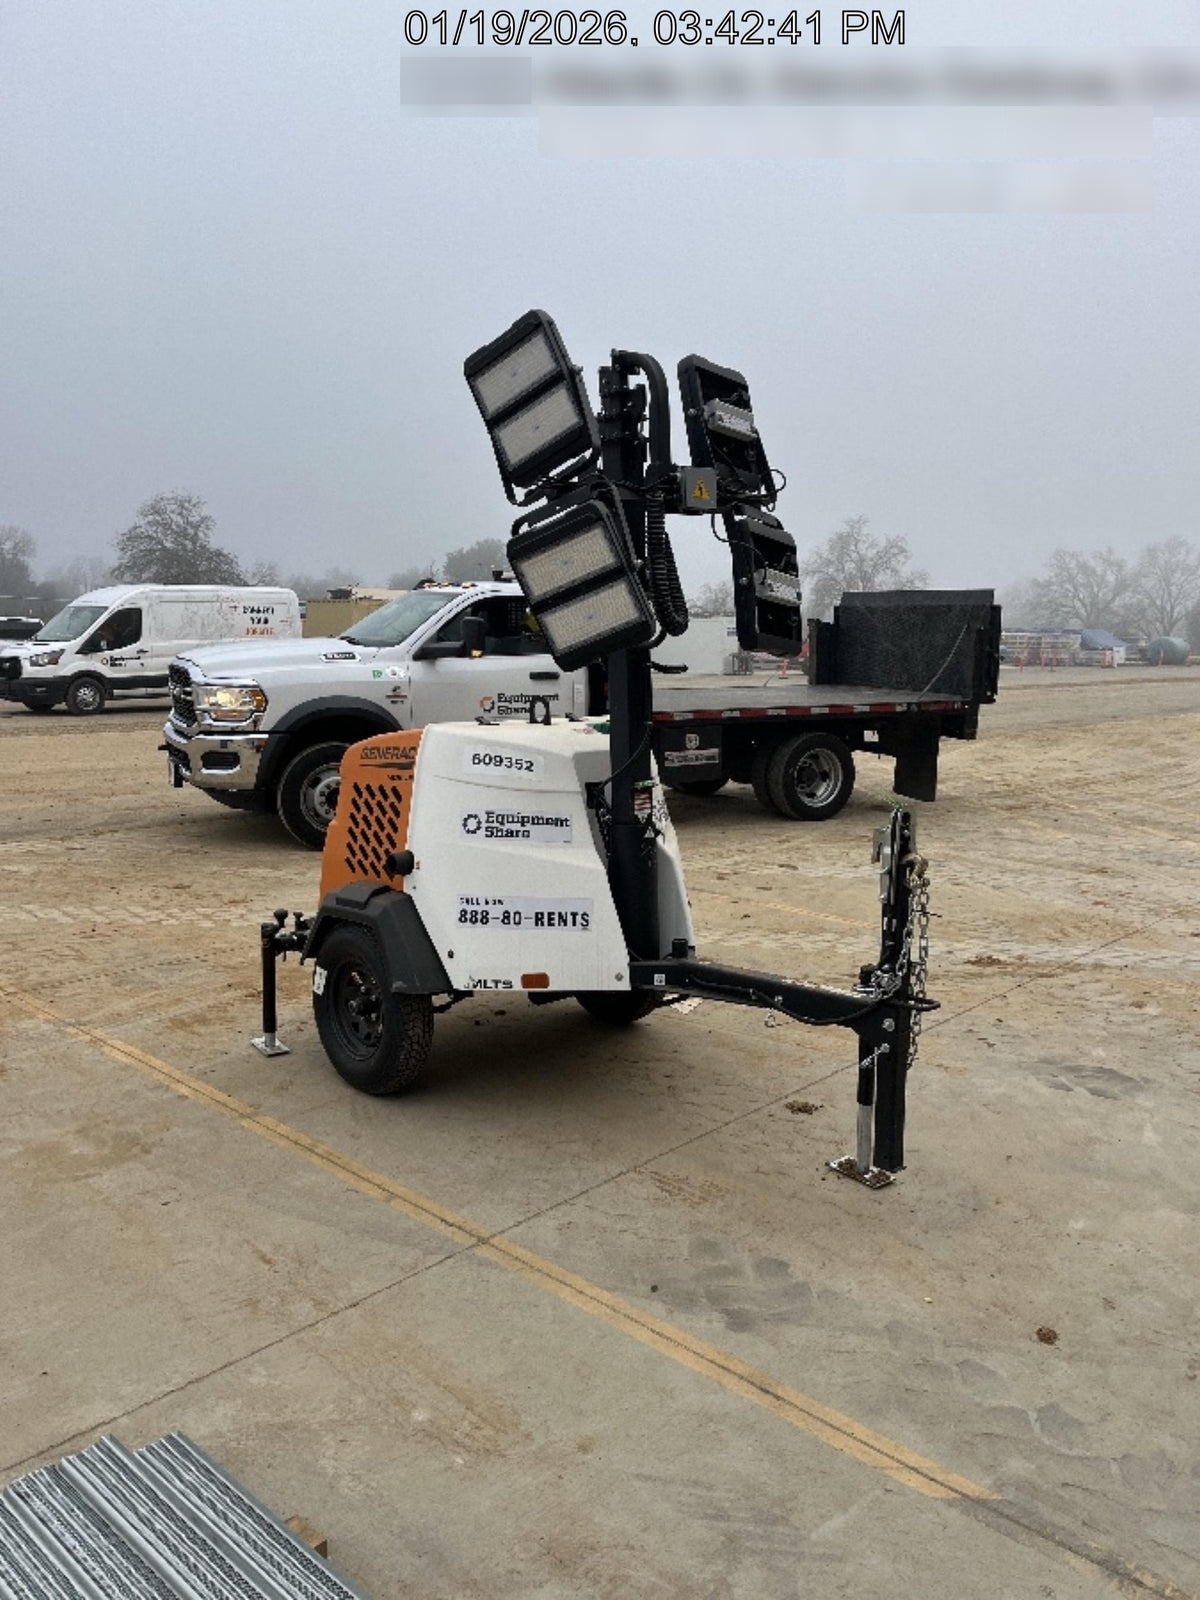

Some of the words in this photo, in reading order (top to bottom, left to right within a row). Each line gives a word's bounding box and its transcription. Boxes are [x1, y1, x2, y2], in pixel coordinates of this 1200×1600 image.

[360, 746, 418, 760] GENERAC
[472, 753, 534, 772] 609352
[485, 811, 571, 827] Equipment
[485, 826, 530, 838] Share
[458, 908, 590, 927] 888-80-RENTS
